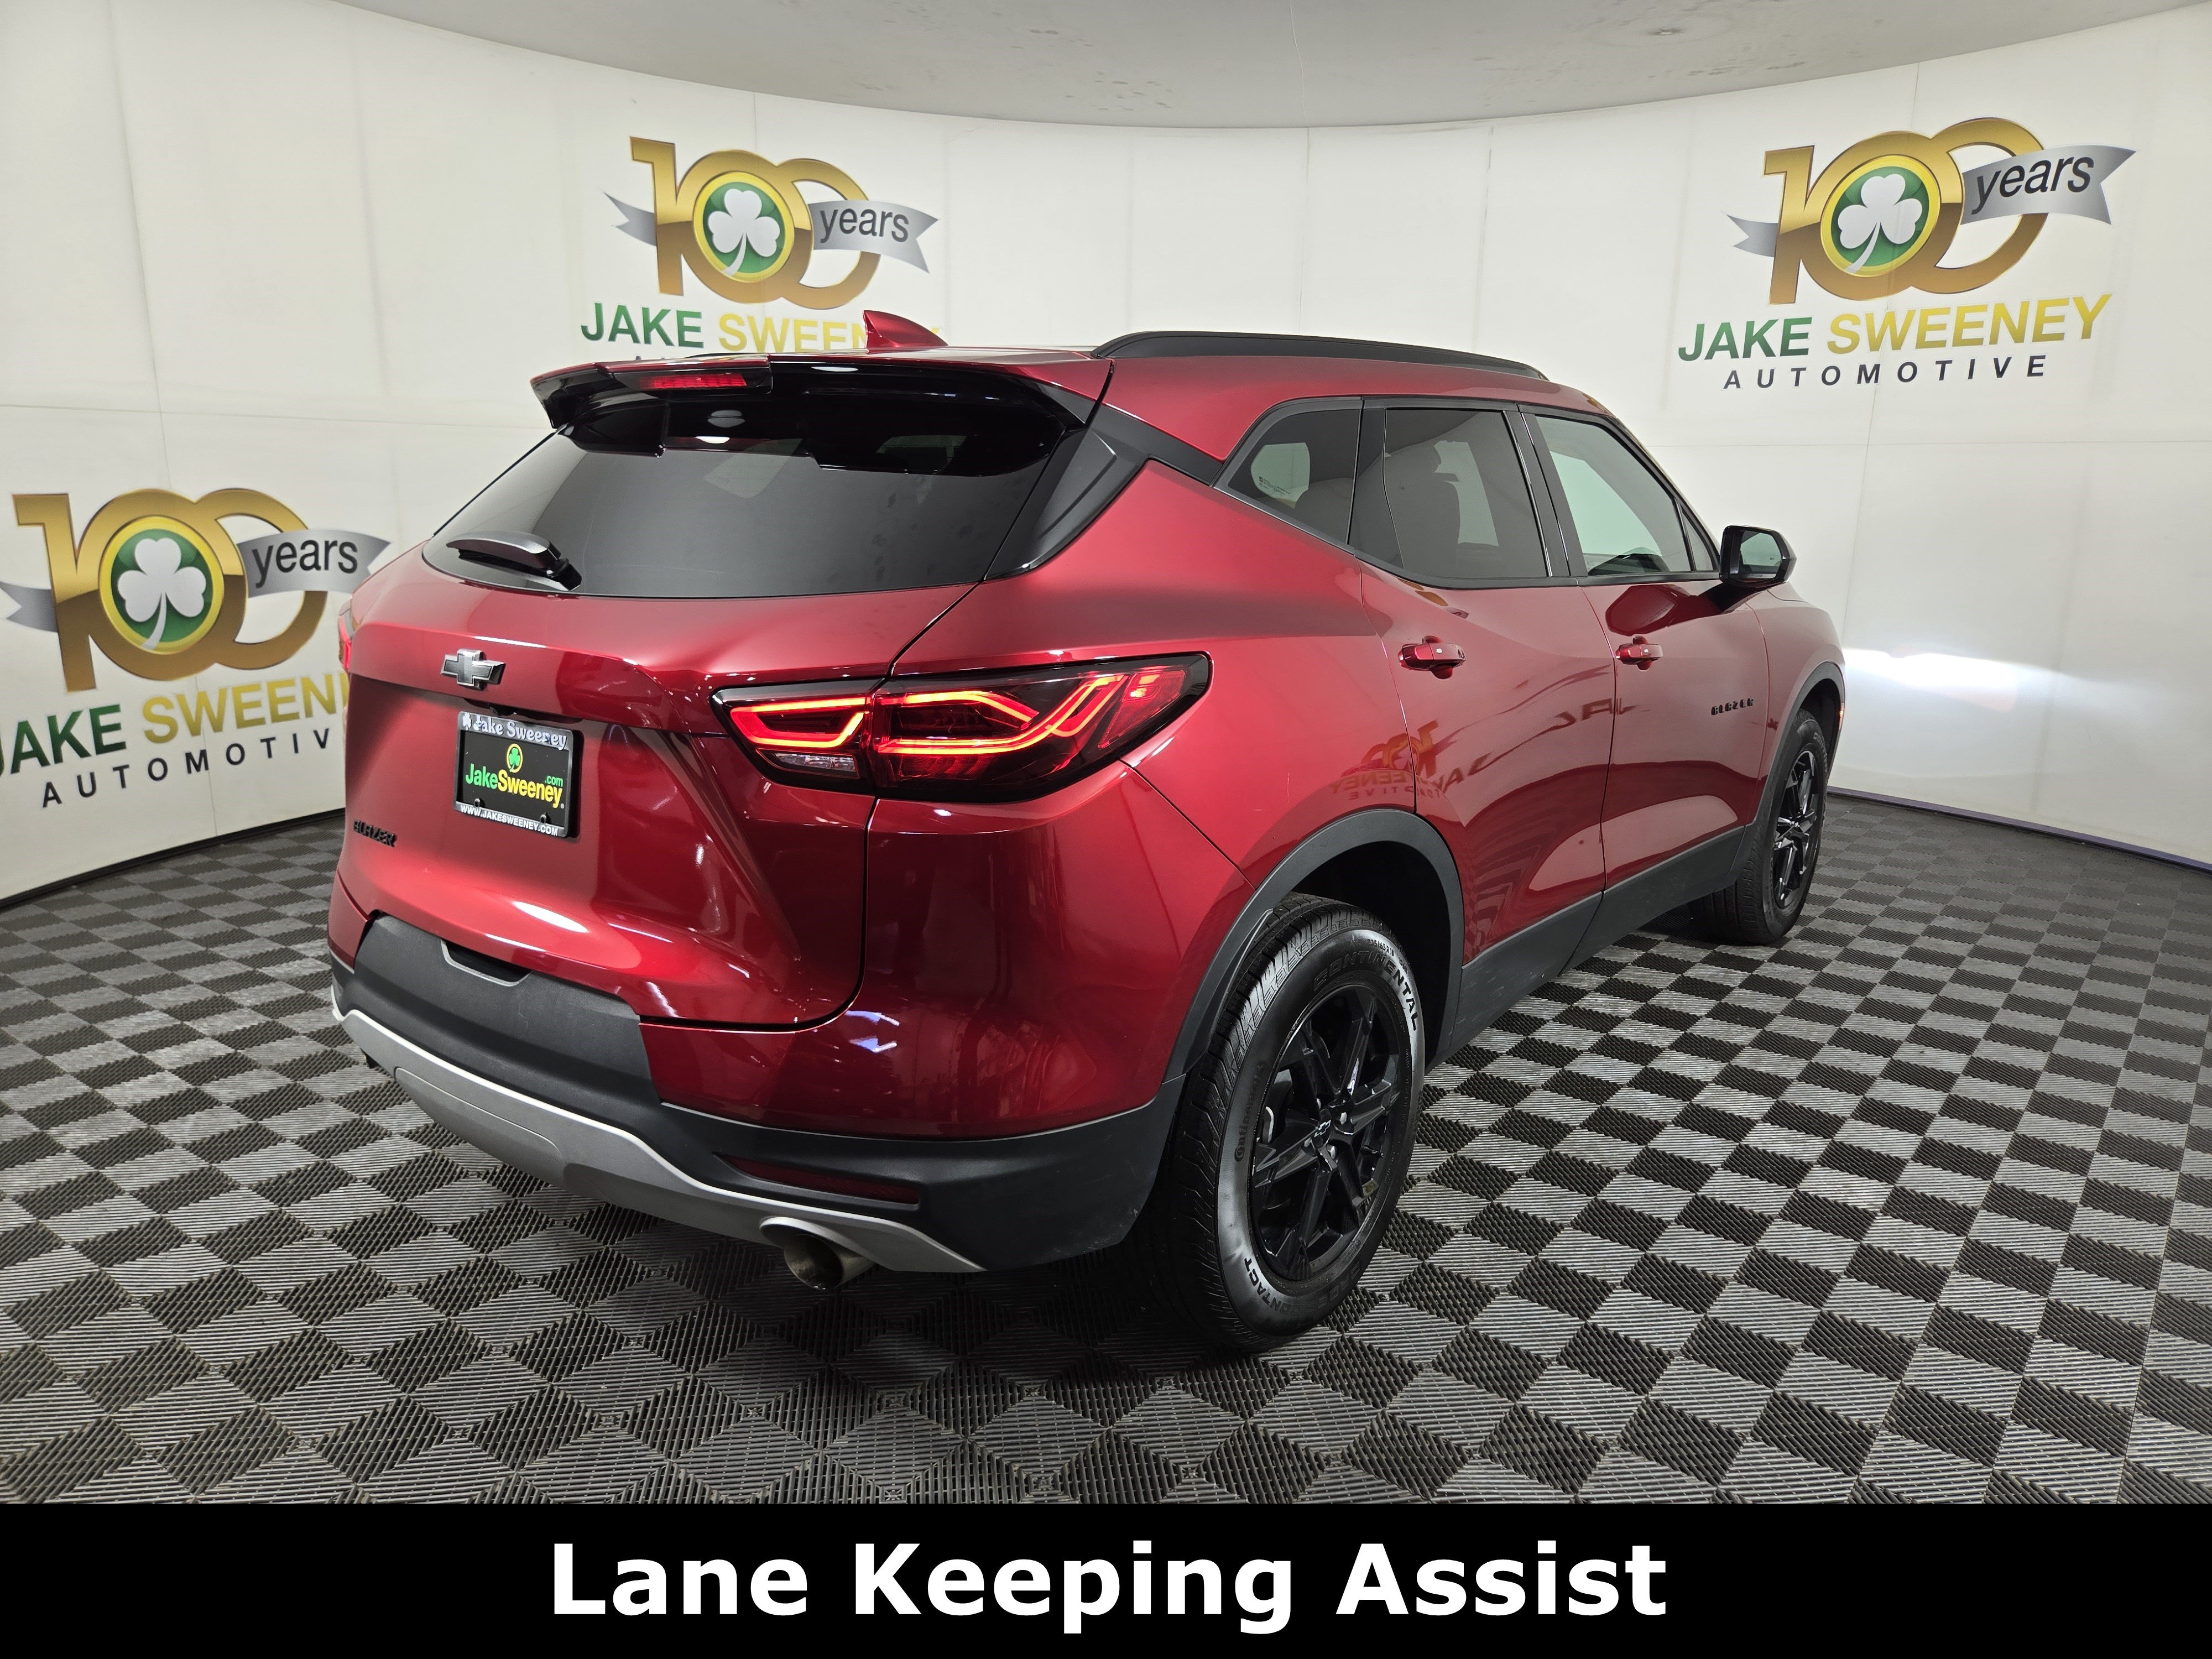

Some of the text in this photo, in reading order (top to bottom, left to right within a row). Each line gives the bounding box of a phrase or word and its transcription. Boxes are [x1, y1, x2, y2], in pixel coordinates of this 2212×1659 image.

[1762, 117, 2051, 305] 100
[1971, 155, 2093, 214] years
[630, 137, 880, 310] 100
[819, 208, 909, 243] years
[581, 302, 704, 348] JAKE
[1678, 294, 2112, 361] JAKE SWEENEY
[1724, 354, 2047, 389] AUTOMOTIVE
[252, 539, 358, 587] years
[12, 488, 328, 693] 100
[143, 672, 349, 744] SWEEN
[507, 721, 567, 750] Sweeney
[42, 728, 330, 808] AUTOMOTIV
[466, 763, 563, 808] JakeSweeney
[354, 820, 396, 847] BLAZER
[460, 805, 559, 837] WWW.JAKESWEENEY.COM
[1314, 950, 1418, 1031] CONTINENTAL
